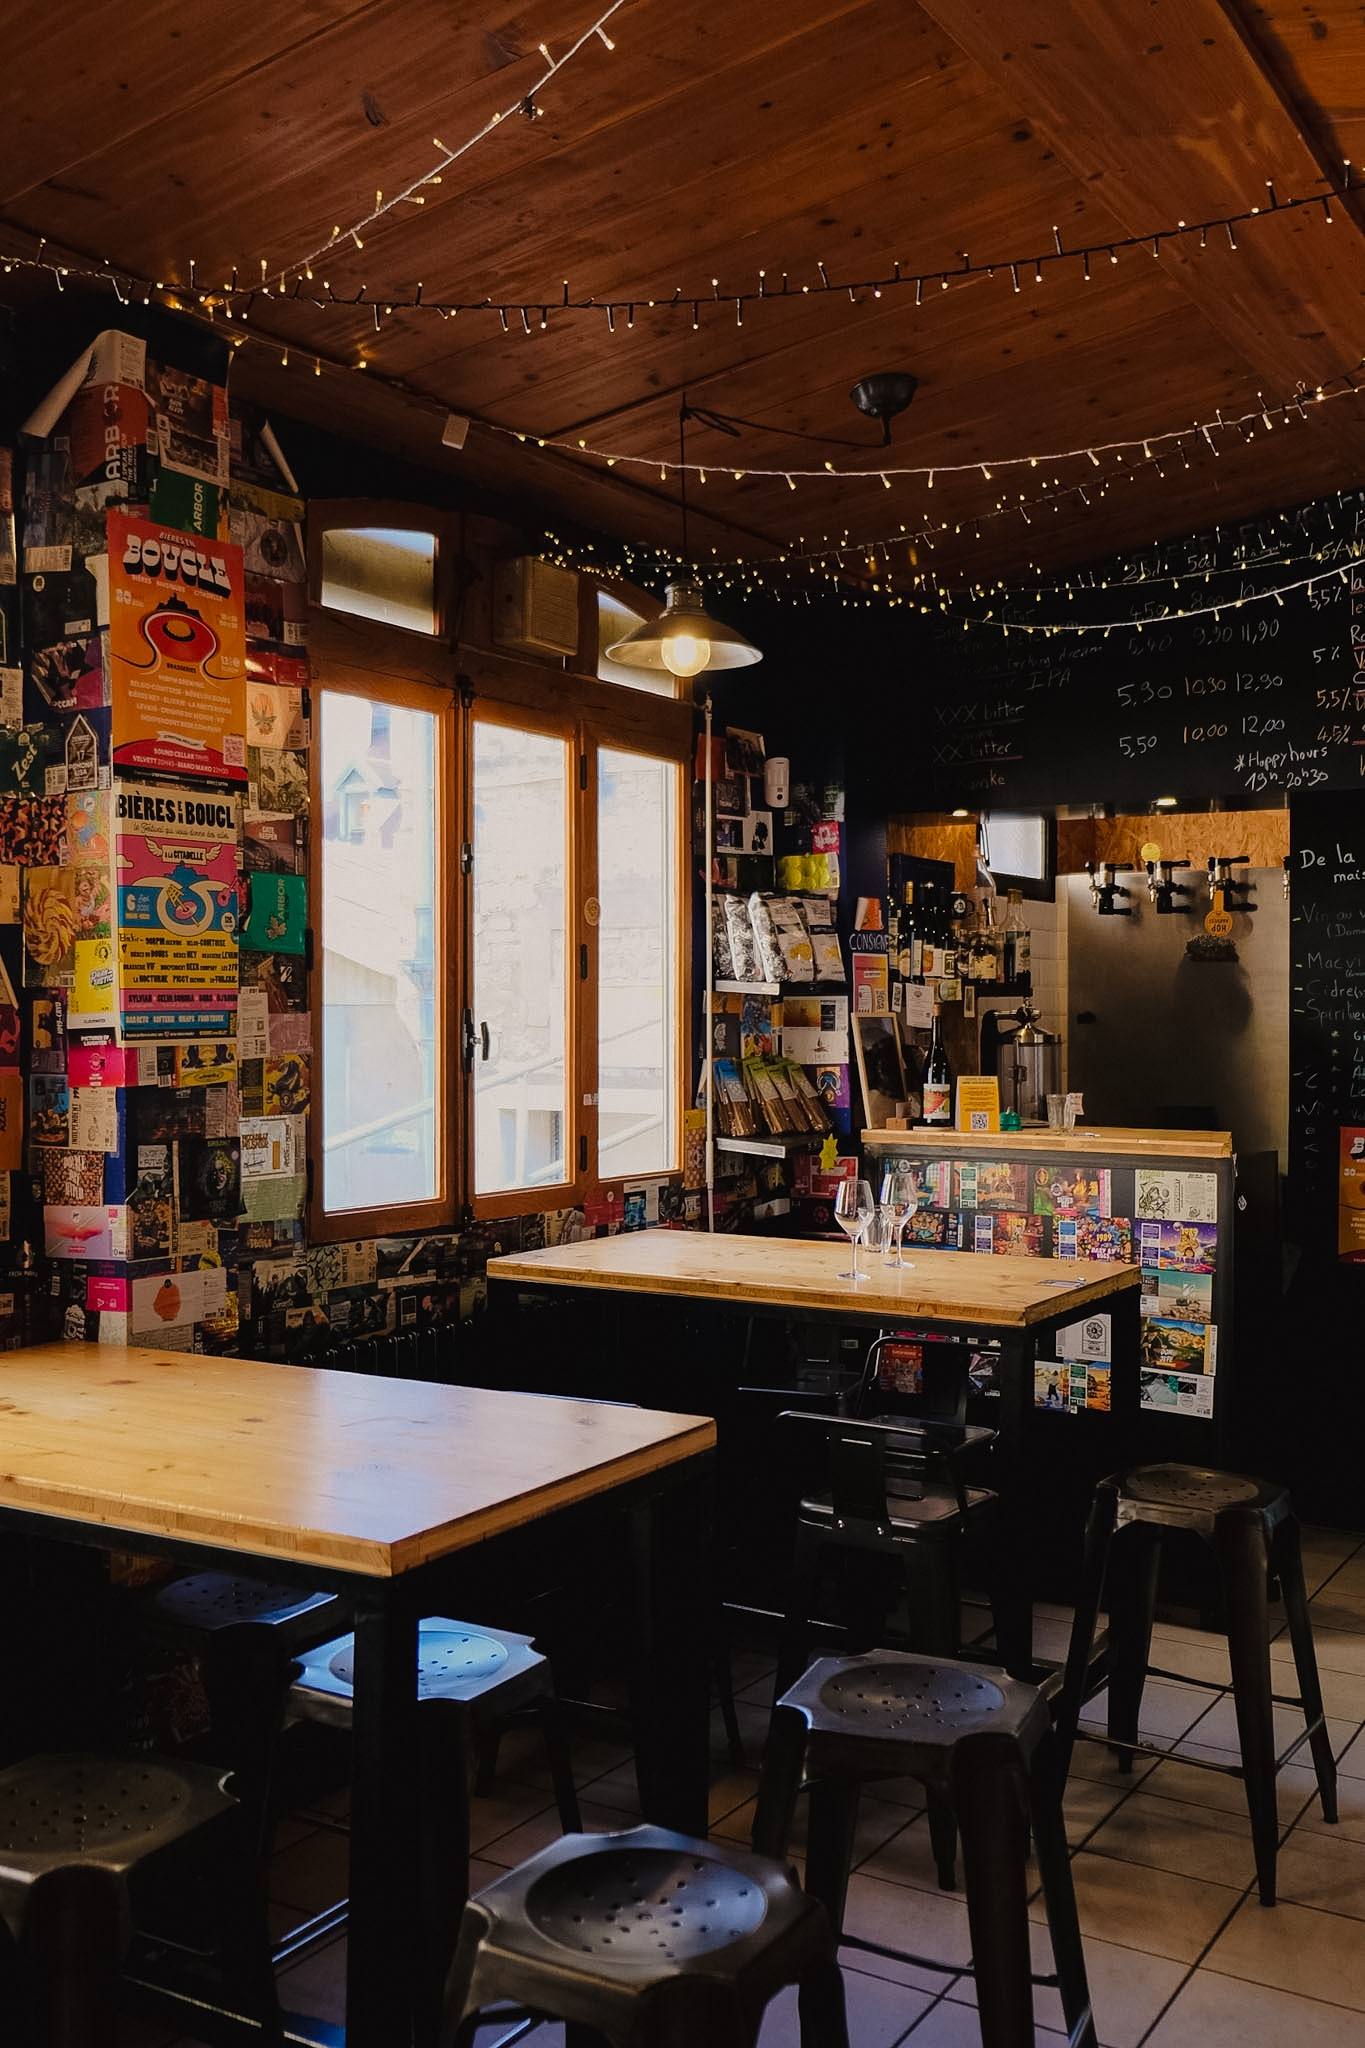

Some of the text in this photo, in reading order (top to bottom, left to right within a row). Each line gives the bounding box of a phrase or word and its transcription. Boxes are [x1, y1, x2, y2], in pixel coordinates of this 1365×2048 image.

[193, 483, 203, 530] ARBOR
[123, 534, 231, 596] BOUCLE
[1241, 619, 1280, 644] 11,90
[1117, 680, 1173, 707] 5,90
[1234, 672, 1283, 692] 12,90
[1119, 715, 1285, 758] 5,50 10,00 12,00
[1288, 742, 1328, 762] hours
[11, 743, 38, 782] Zest
[117, 791, 176, 823] BIÈRES
[1300, 843, 1356, 869] De la
[277, 879, 286, 920] ARBOR
